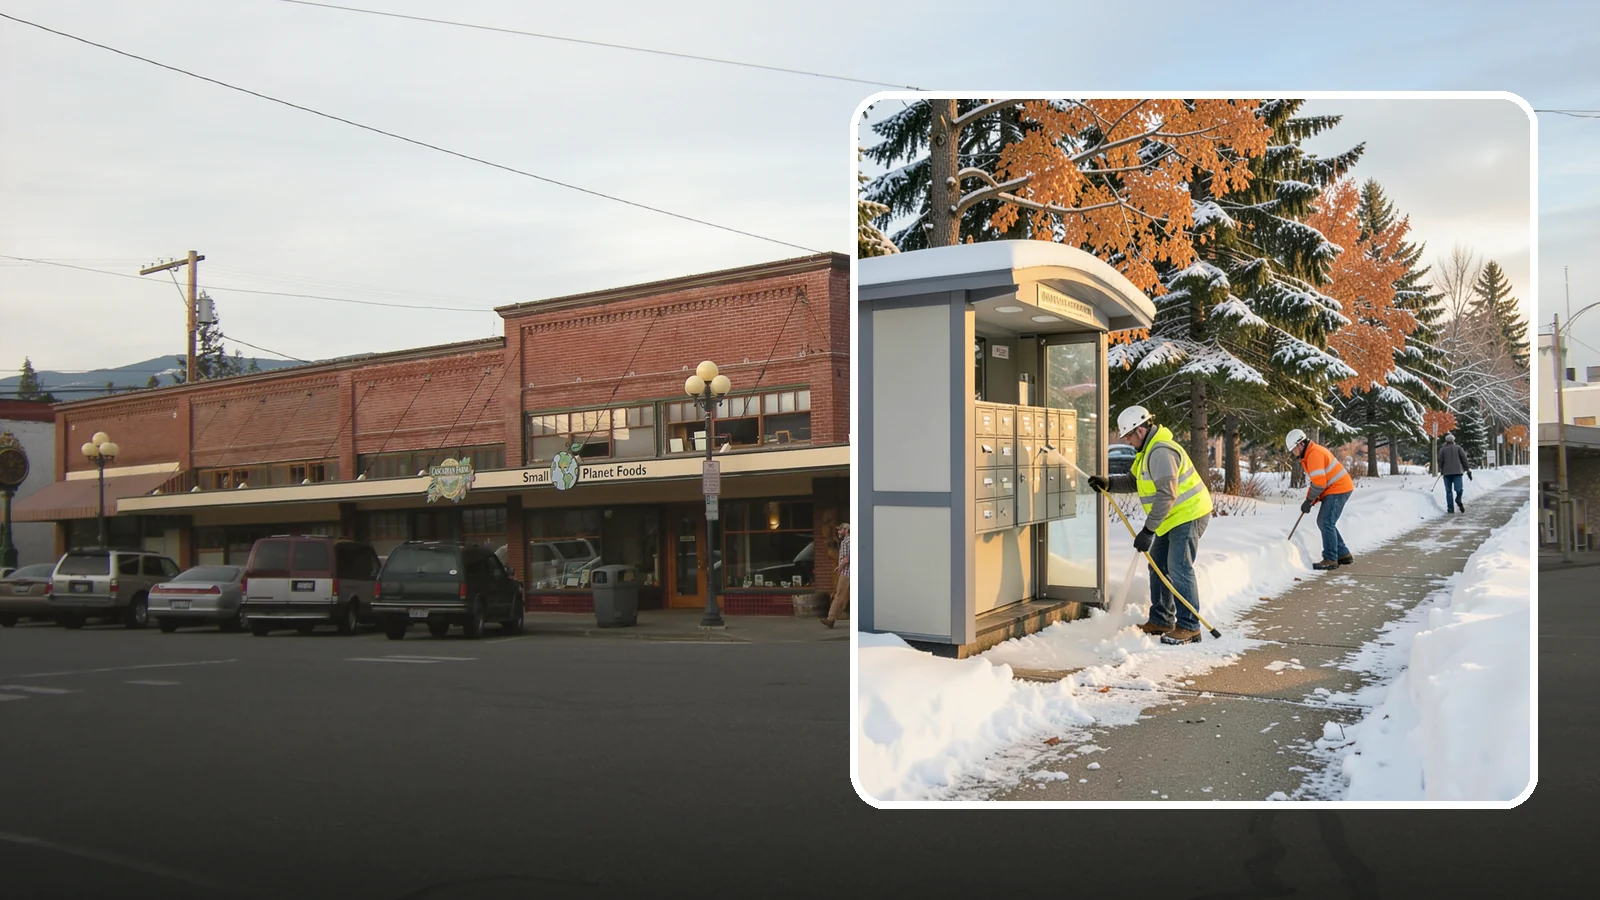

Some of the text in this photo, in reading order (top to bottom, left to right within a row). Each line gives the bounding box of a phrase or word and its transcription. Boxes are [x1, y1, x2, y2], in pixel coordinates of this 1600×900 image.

[523, 464, 647, 483] Small Planet Foods
